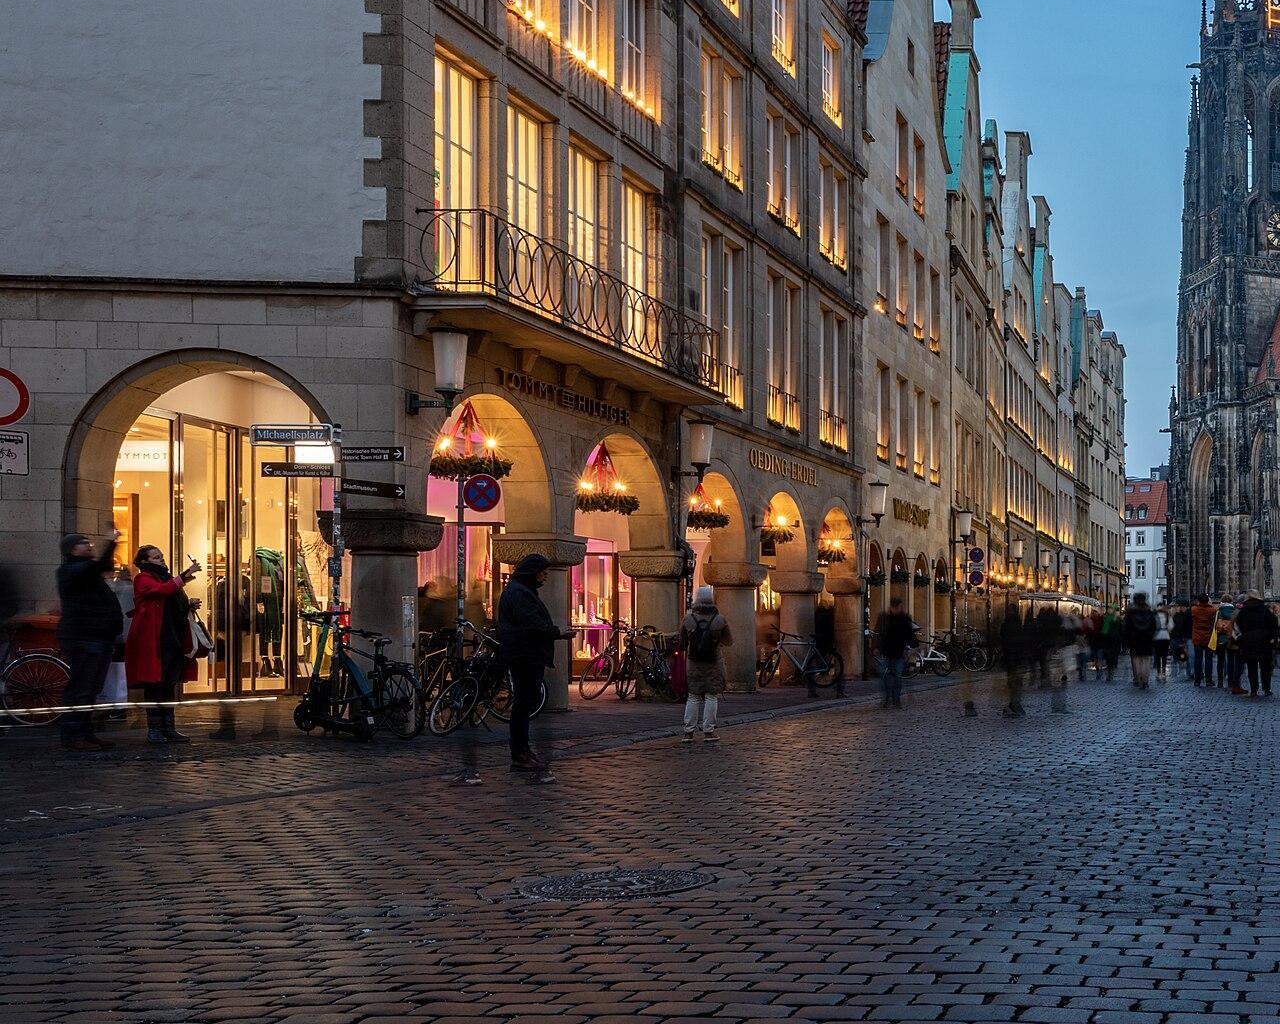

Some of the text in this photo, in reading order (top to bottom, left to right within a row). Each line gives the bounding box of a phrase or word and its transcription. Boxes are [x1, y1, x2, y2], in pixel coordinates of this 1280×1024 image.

[496, 368, 631, 424] TOMMY HILFIGER
[257, 430, 324, 440] Michaelisplatz
[343, 483, 378, 492] Stadtmuseum
